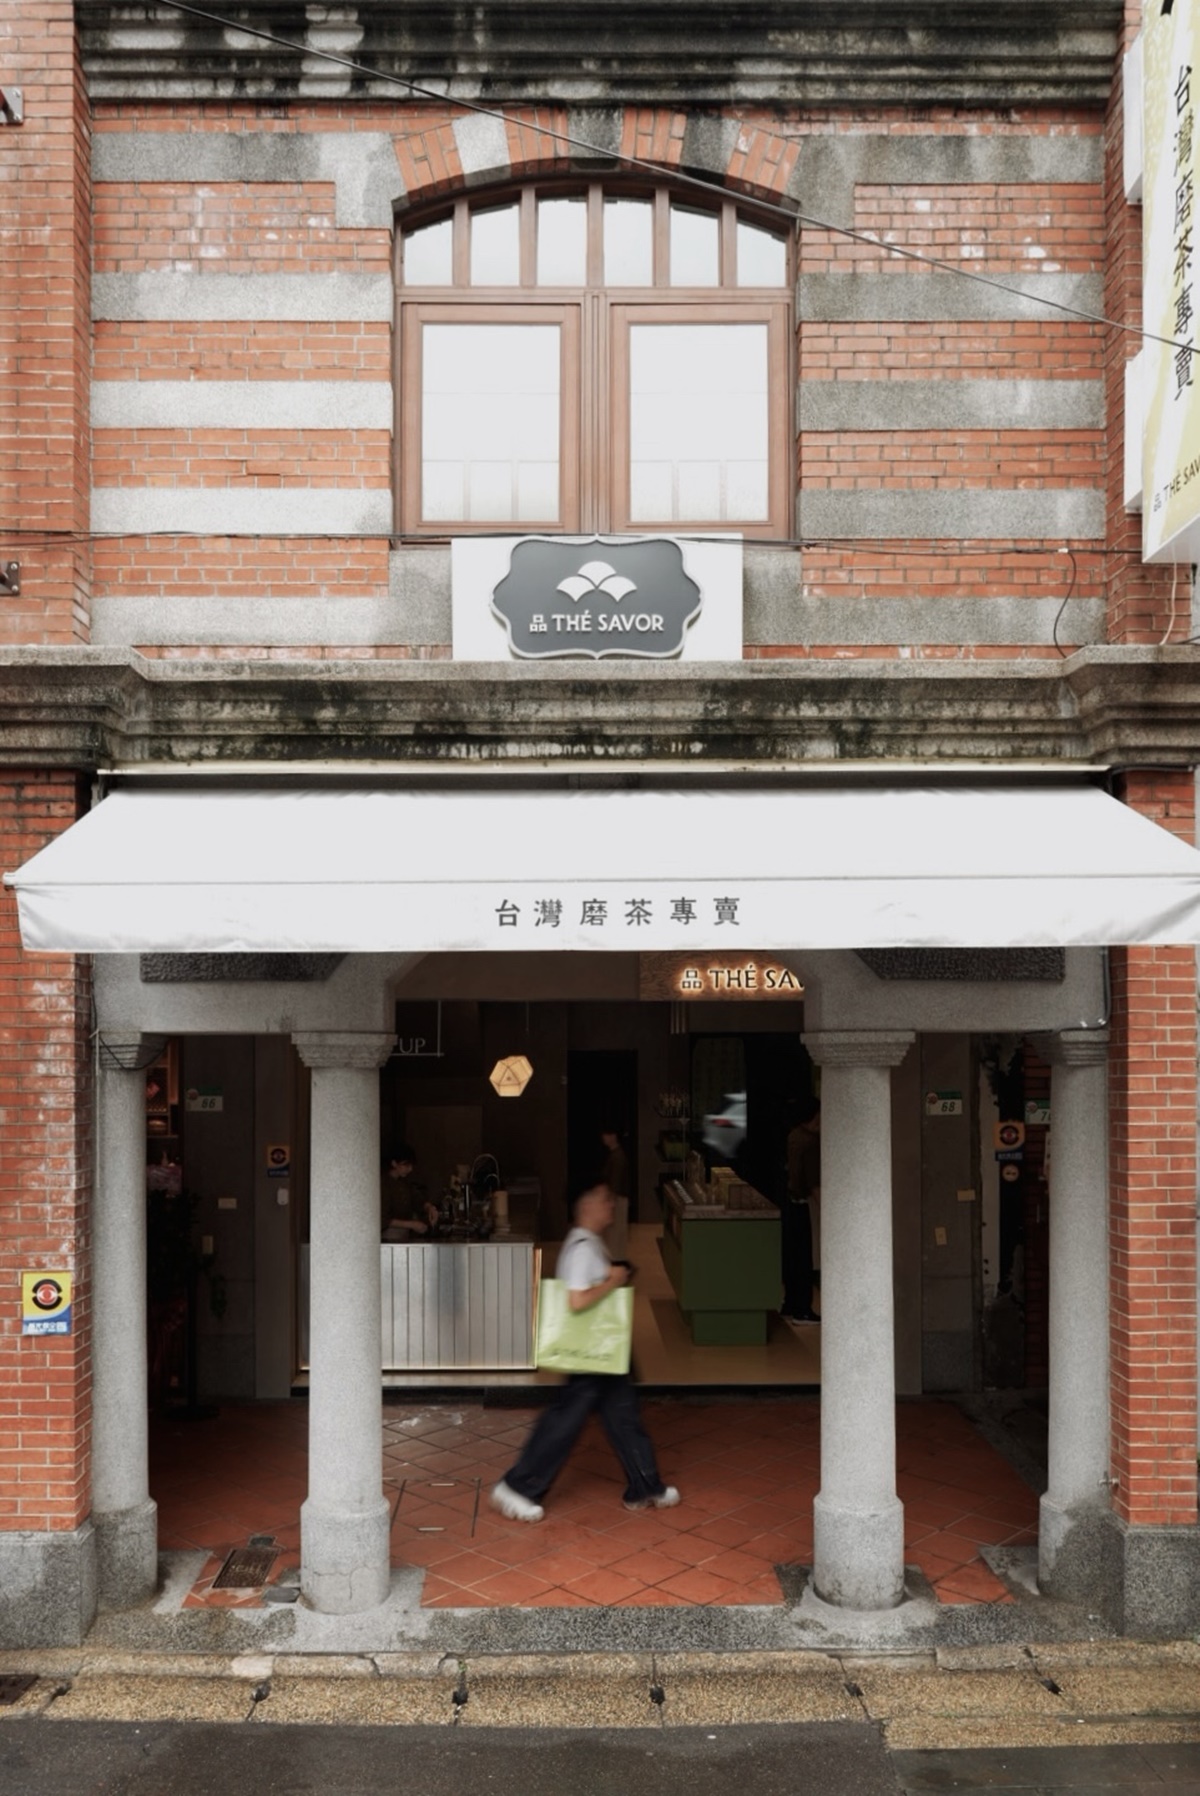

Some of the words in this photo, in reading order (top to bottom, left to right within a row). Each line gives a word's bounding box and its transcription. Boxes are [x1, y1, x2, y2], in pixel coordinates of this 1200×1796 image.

[1174, 64, 1194, 401] 台灣磨茶專賣
[551, 610, 592, 632] THÉ
[598, 614, 664, 632] SAVOR
[494, 896, 741, 928] 台灣磨茶專賣
[708, 964, 758, 989] THÉ
[765, 969, 805, 989] SA
[399, 1037, 426, 1054] UP
[941, 1101, 956, 1113] 68
